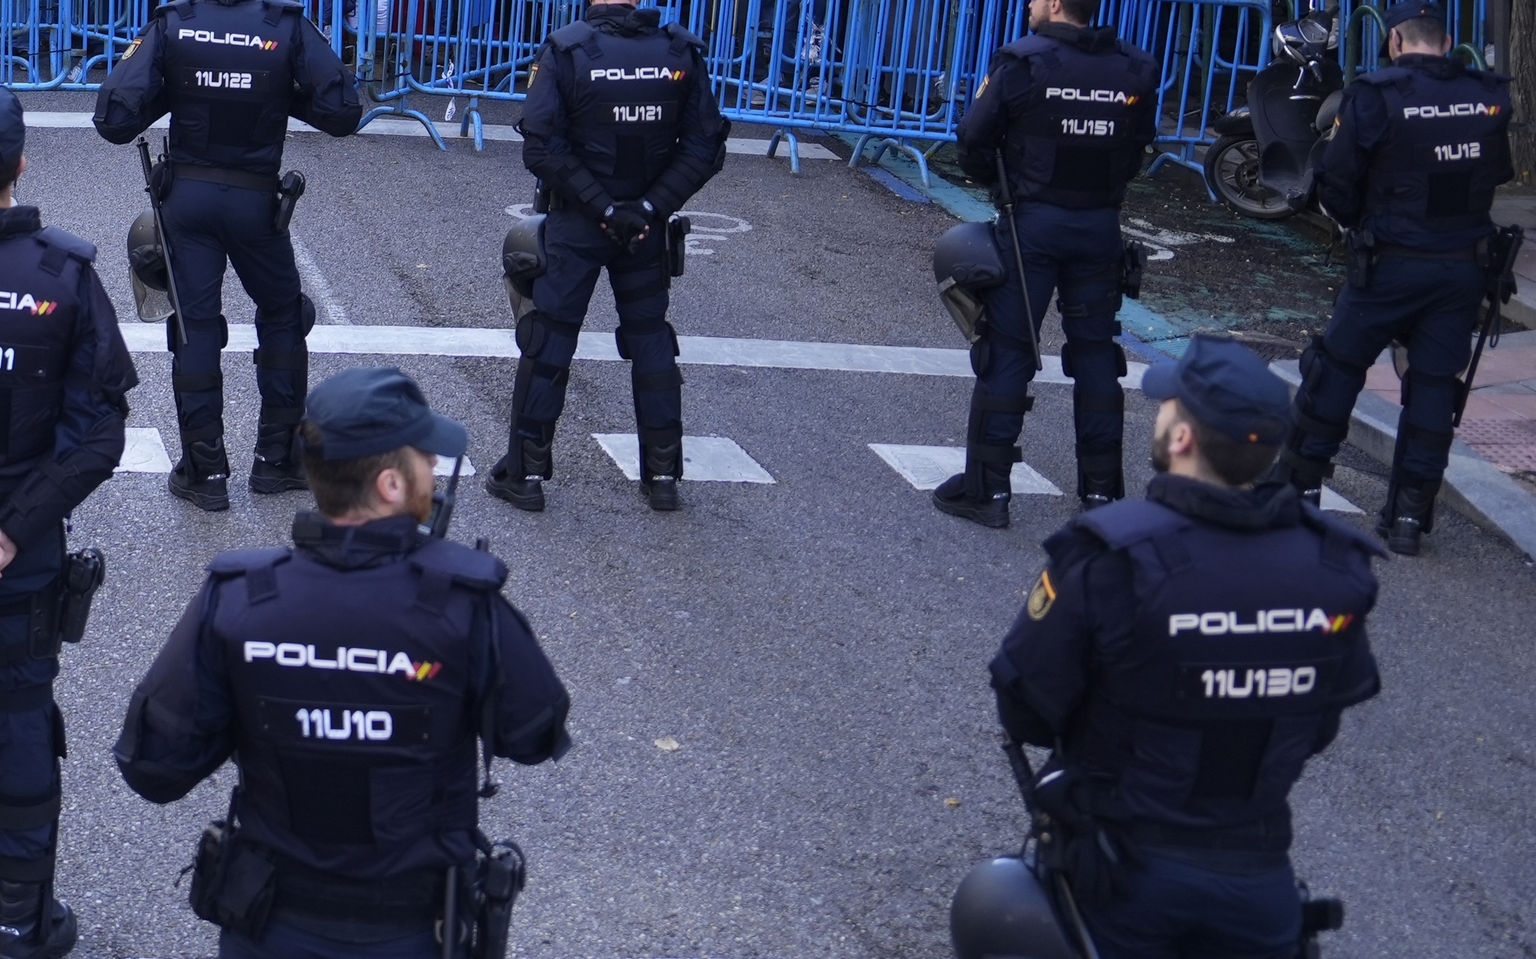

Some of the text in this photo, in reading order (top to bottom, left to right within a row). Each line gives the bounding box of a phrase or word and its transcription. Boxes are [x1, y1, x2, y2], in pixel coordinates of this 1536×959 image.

[178, 28, 263, 45] POLICIA
[195, 70, 252, 89] 11U122
[590, 66, 671, 81] POLICIA
[1045, 87, 1126, 103] POLICIA
[612, 105, 662, 122] 11U121
[1403, 102, 1487, 119] POLICIA
[1061, 118, 1115, 136] 11U151
[1434, 142, 1481, 161] 11U12
[1169, 608, 1329, 636] POLICIA
[243, 640, 415, 675] POLICIA
[1201, 667, 1316, 698] 11U130
[296, 708, 393, 741] 11U10
